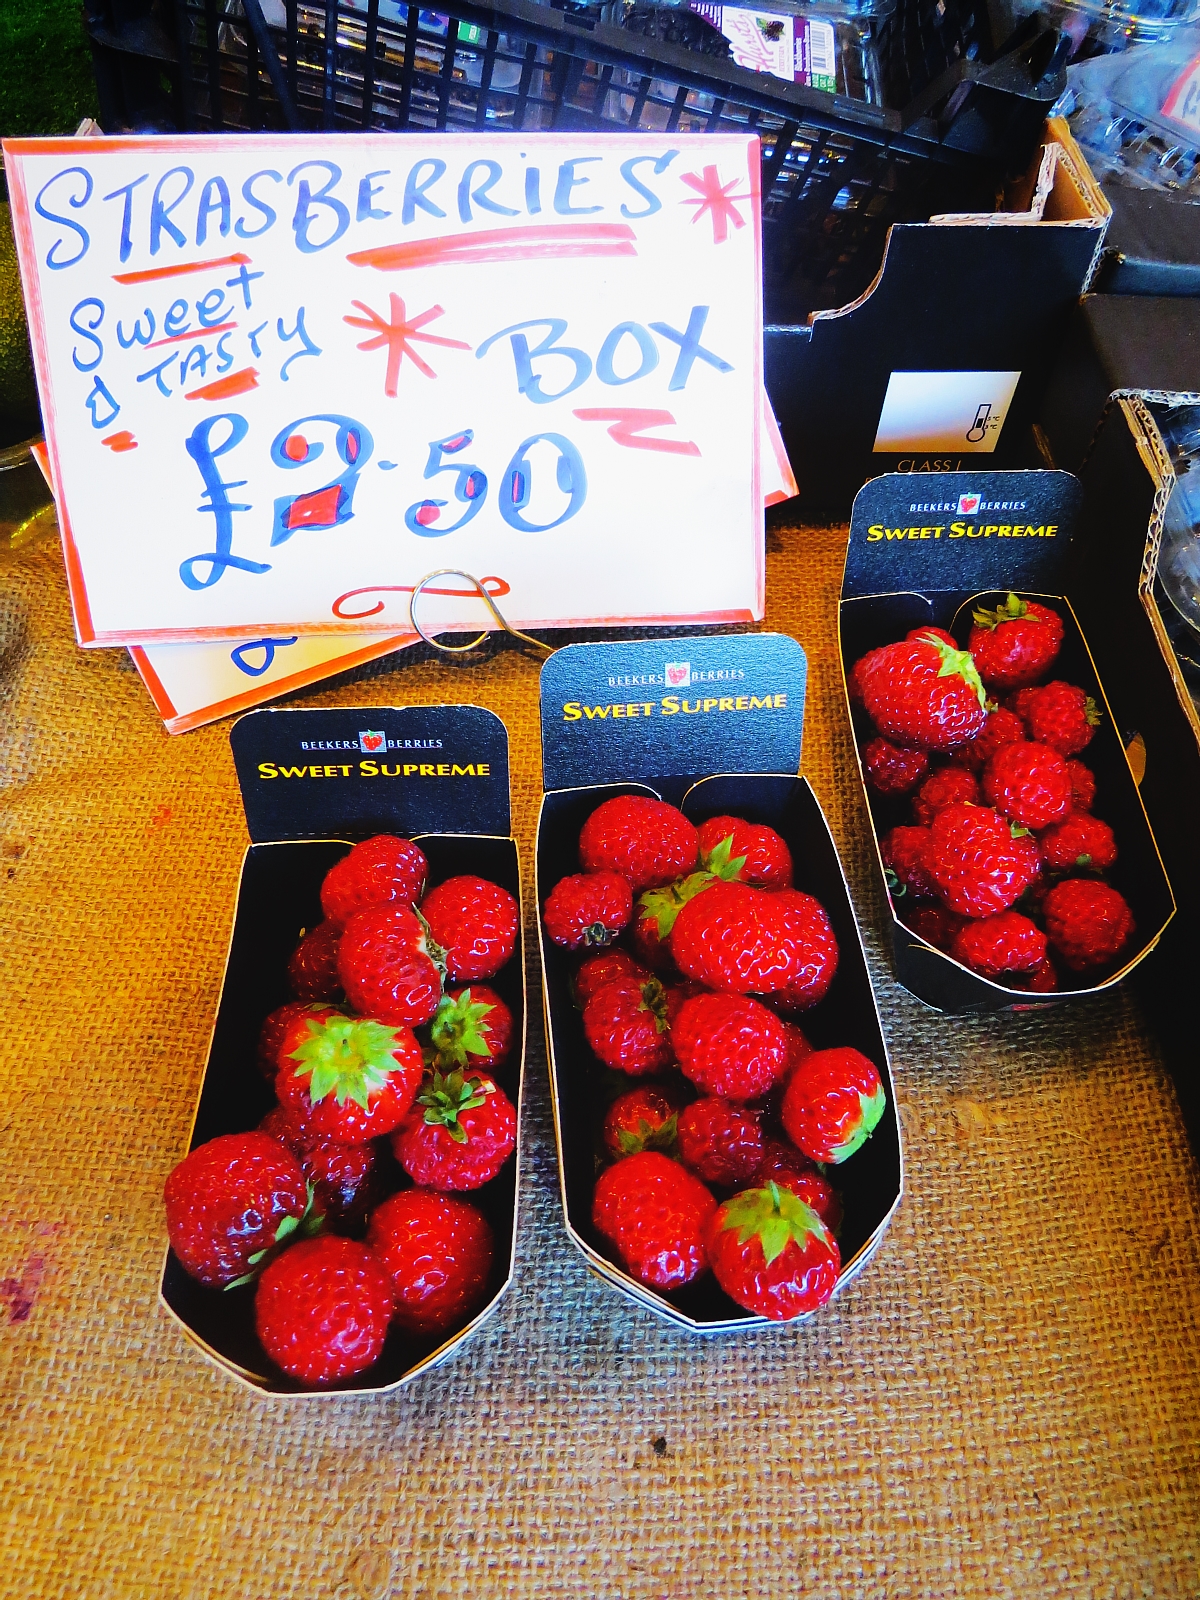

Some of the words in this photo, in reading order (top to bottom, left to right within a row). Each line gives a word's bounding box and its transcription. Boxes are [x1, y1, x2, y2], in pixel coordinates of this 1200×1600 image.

[475, 305, 735, 404] BOX
[897, 459, 952, 472] CLASS
[909, 502, 957, 513] BEEKERS
[979, 500, 1027, 511] BERRIES
[607, 673, 664, 687] BEEKERS
[691, 668, 745, 681] BERRIES
[300, 739, 359, 749] BEEKERS
[387, 738, 443, 748] BERRIES
